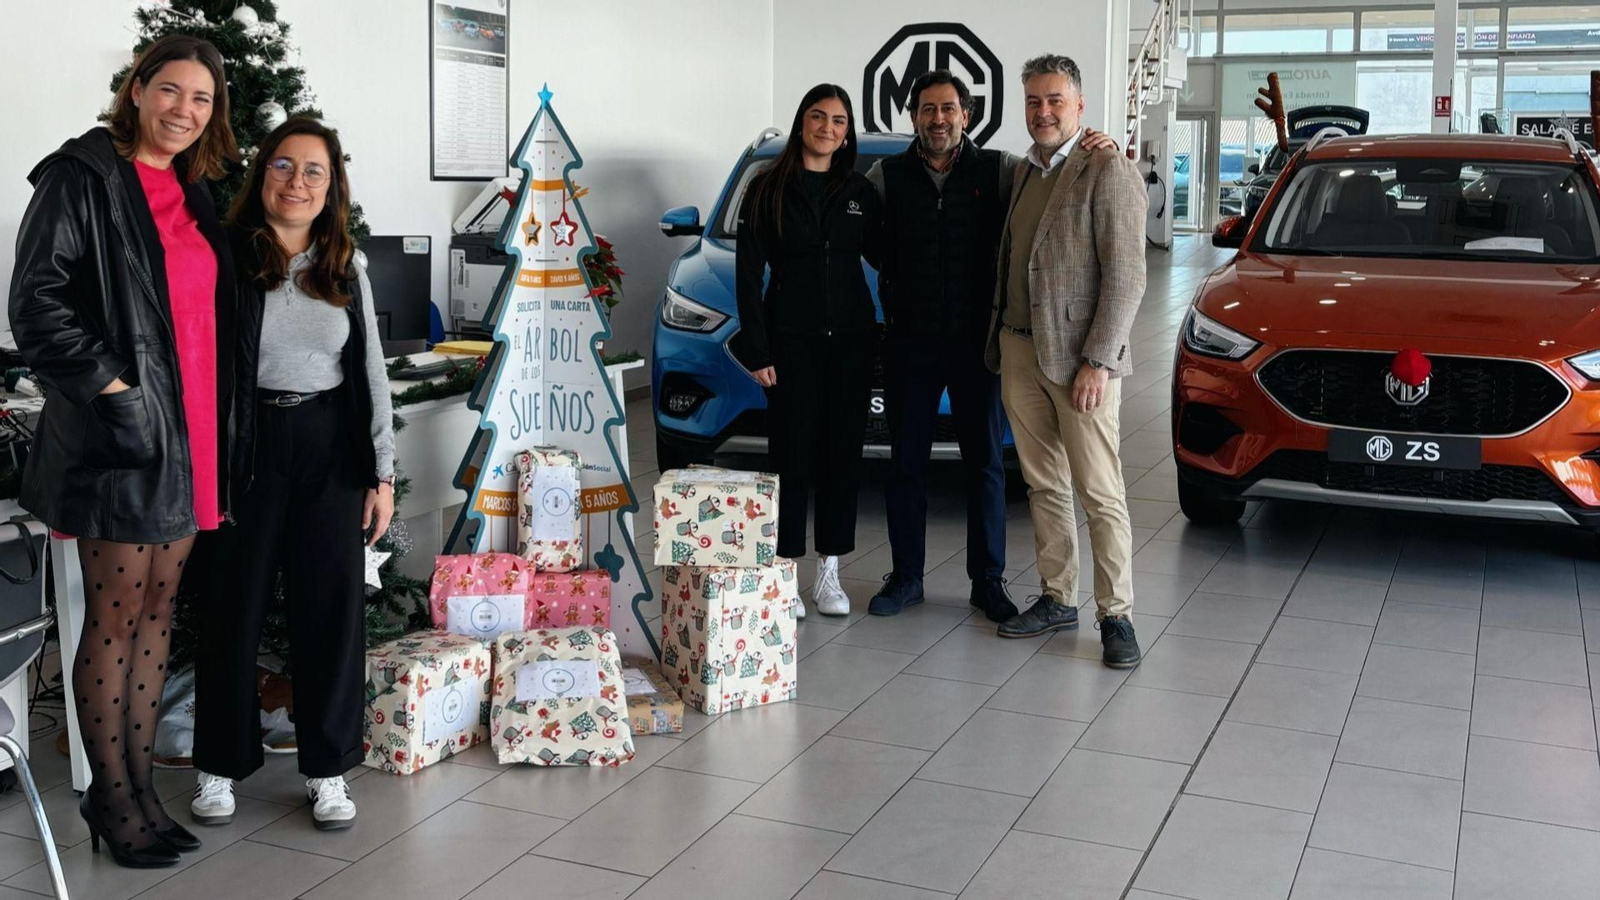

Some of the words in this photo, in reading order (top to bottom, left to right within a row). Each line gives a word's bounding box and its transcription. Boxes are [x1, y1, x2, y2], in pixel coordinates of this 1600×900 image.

[1507, 32, 1536, 41] NFIANZA
[1521, 123, 1556, 135] SALA
[517, 300, 541, 313] SOLICITA
[550, 300, 566, 311] UNA
[567, 300, 591, 312] CARTA
[514, 335, 521, 350] EL
[524, 318, 582, 363] ÁRBOL
[521, 366, 528, 381] DE
[531, 365, 541, 380] LOS
[509, 384, 594, 441] SUEÑOS
[1368, 437, 1391, 459] MG
[1405, 441, 1440, 462] ZS
[482, 494, 512, 512] MARCOS
[585, 494, 592, 508] 5
[593, 489, 619, 507] AÑOS
